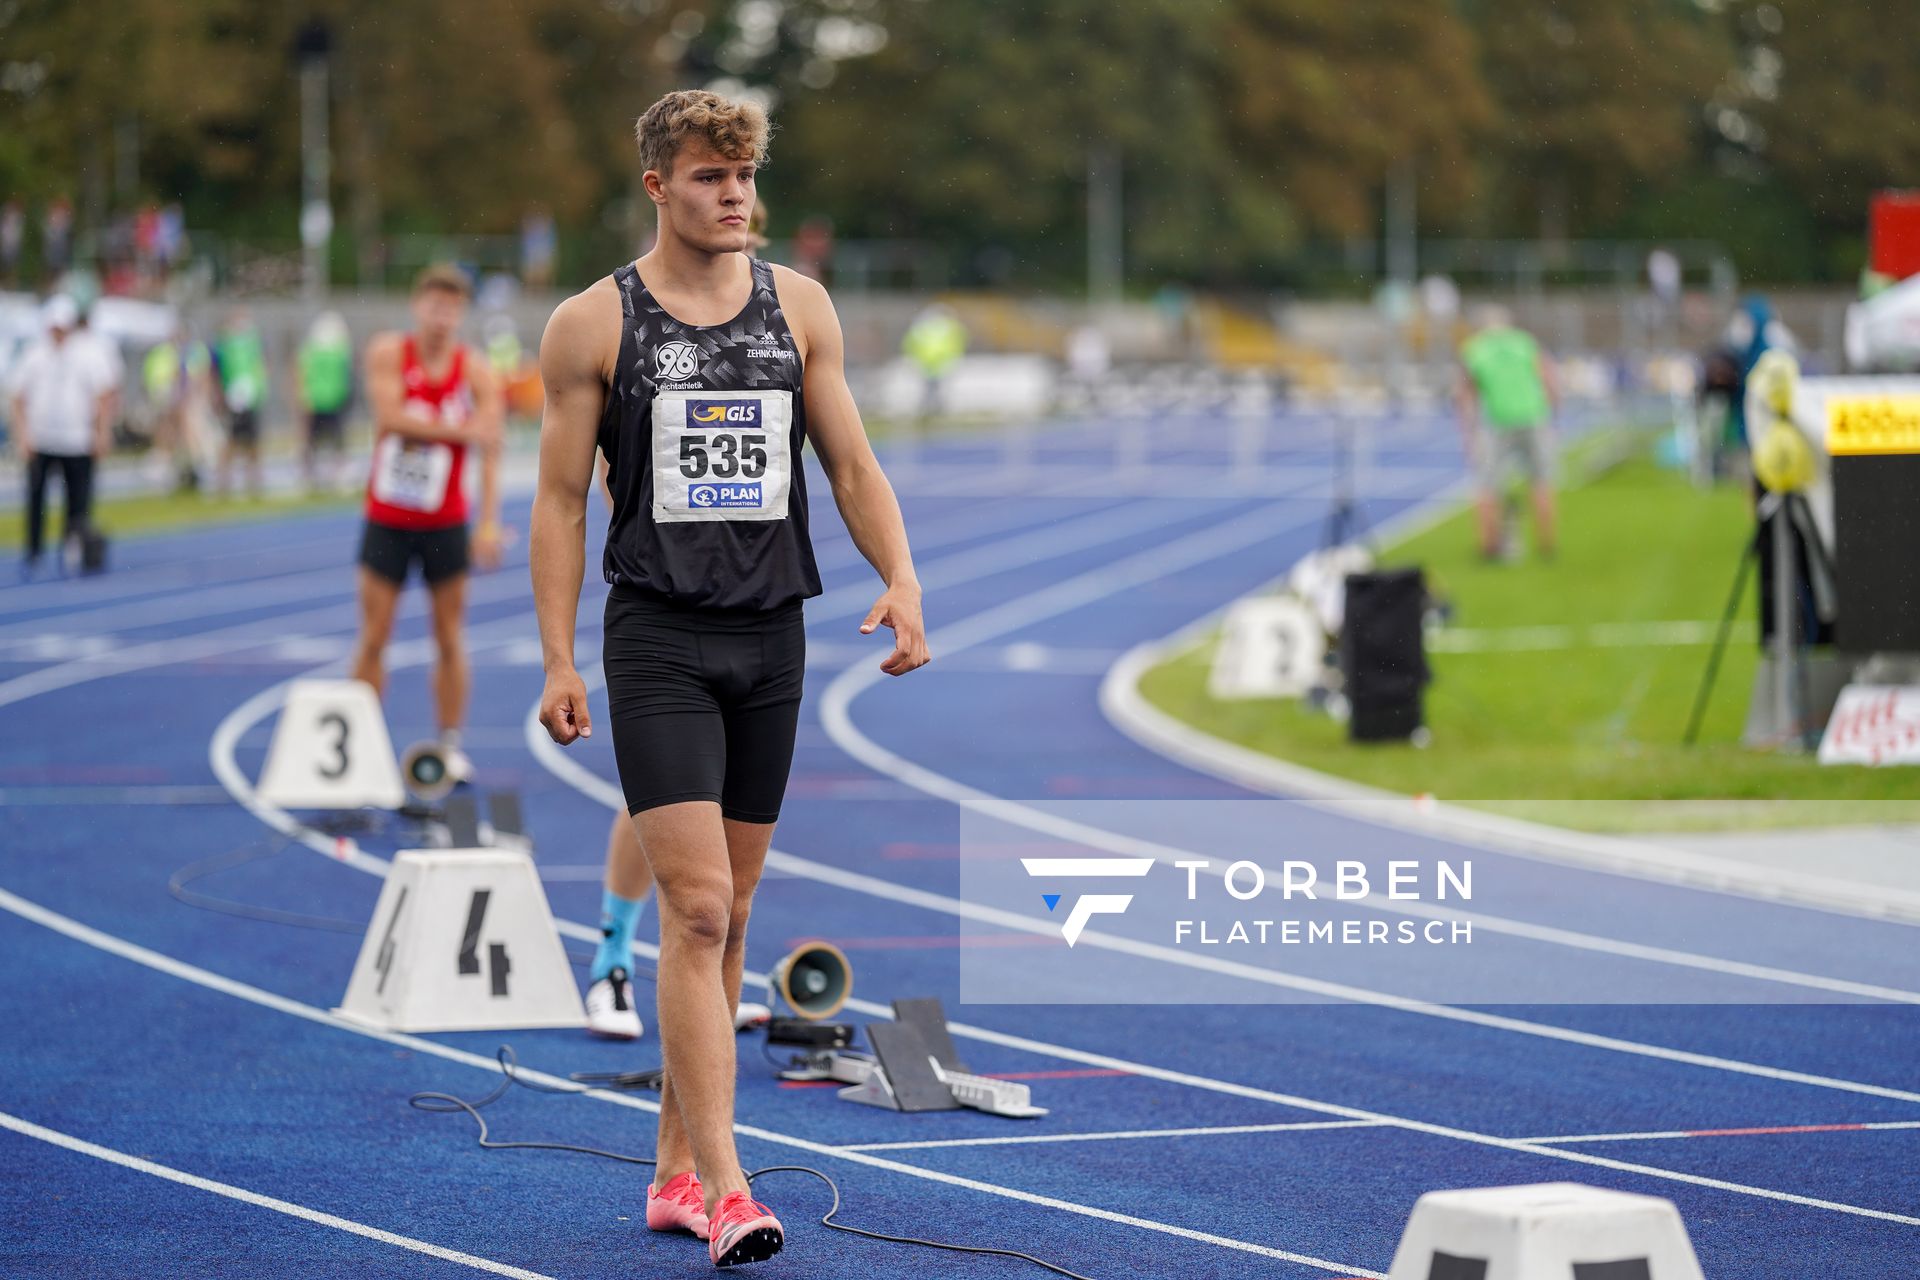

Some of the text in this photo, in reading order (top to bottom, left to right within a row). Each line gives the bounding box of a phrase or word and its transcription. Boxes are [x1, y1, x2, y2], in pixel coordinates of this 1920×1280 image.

[658, 343, 696, 378] 96
[655, 381, 703, 391] Leichtathletik
[726, 406, 755, 421] GLS
[679, 434, 767, 479] 535
[720, 488, 759, 500] PLAN
[317, 712, 350, 780] 3
[458, 890, 511, 996] 4
